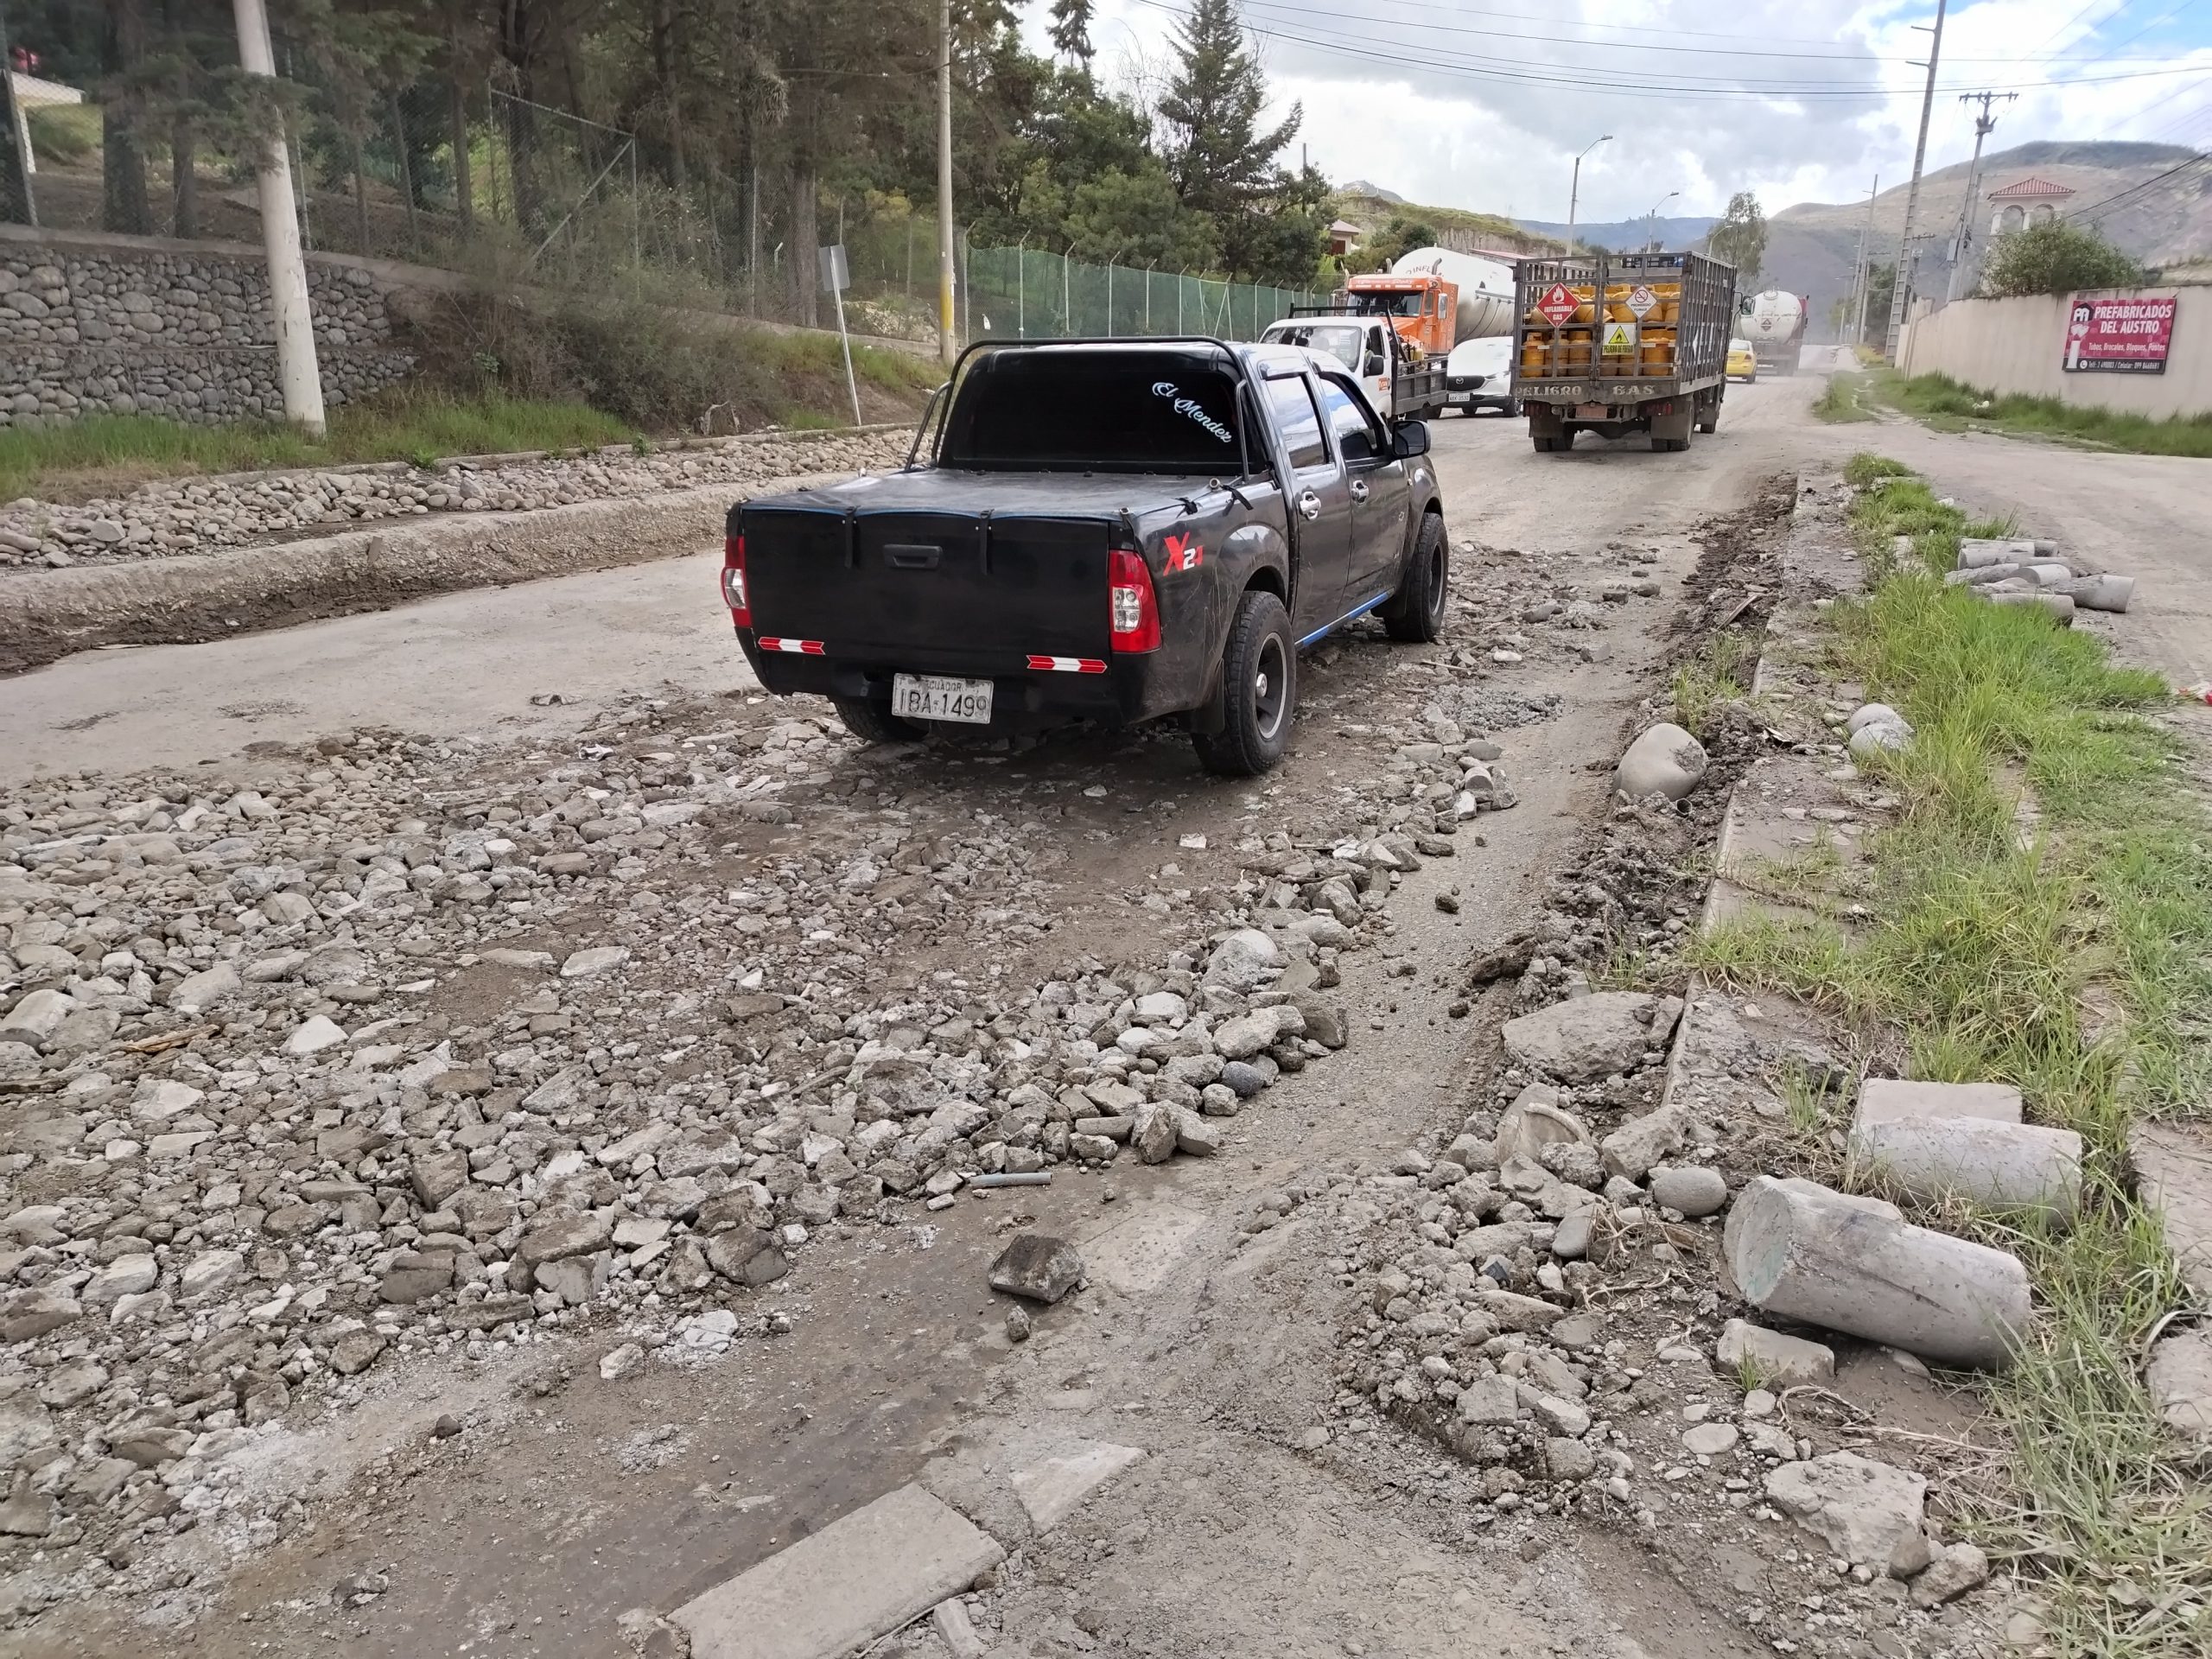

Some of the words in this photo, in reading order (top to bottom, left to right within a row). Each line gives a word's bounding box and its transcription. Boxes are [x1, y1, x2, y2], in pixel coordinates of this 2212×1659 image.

[2094, 305, 2172, 319] PREFABRICADOS
[2101, 321, 2118, 334] DEL
[2120, 321, 2159, 334] AUSTRO
[2088, 342, 2102, 351] Tubos,
[1152, 382, 1179, 397] El
[1515, 385, 1582, 397] PELIGRO
[1613, 385, 1655, 396] GAS
[1174, 397, 1232, 443] Mendez
